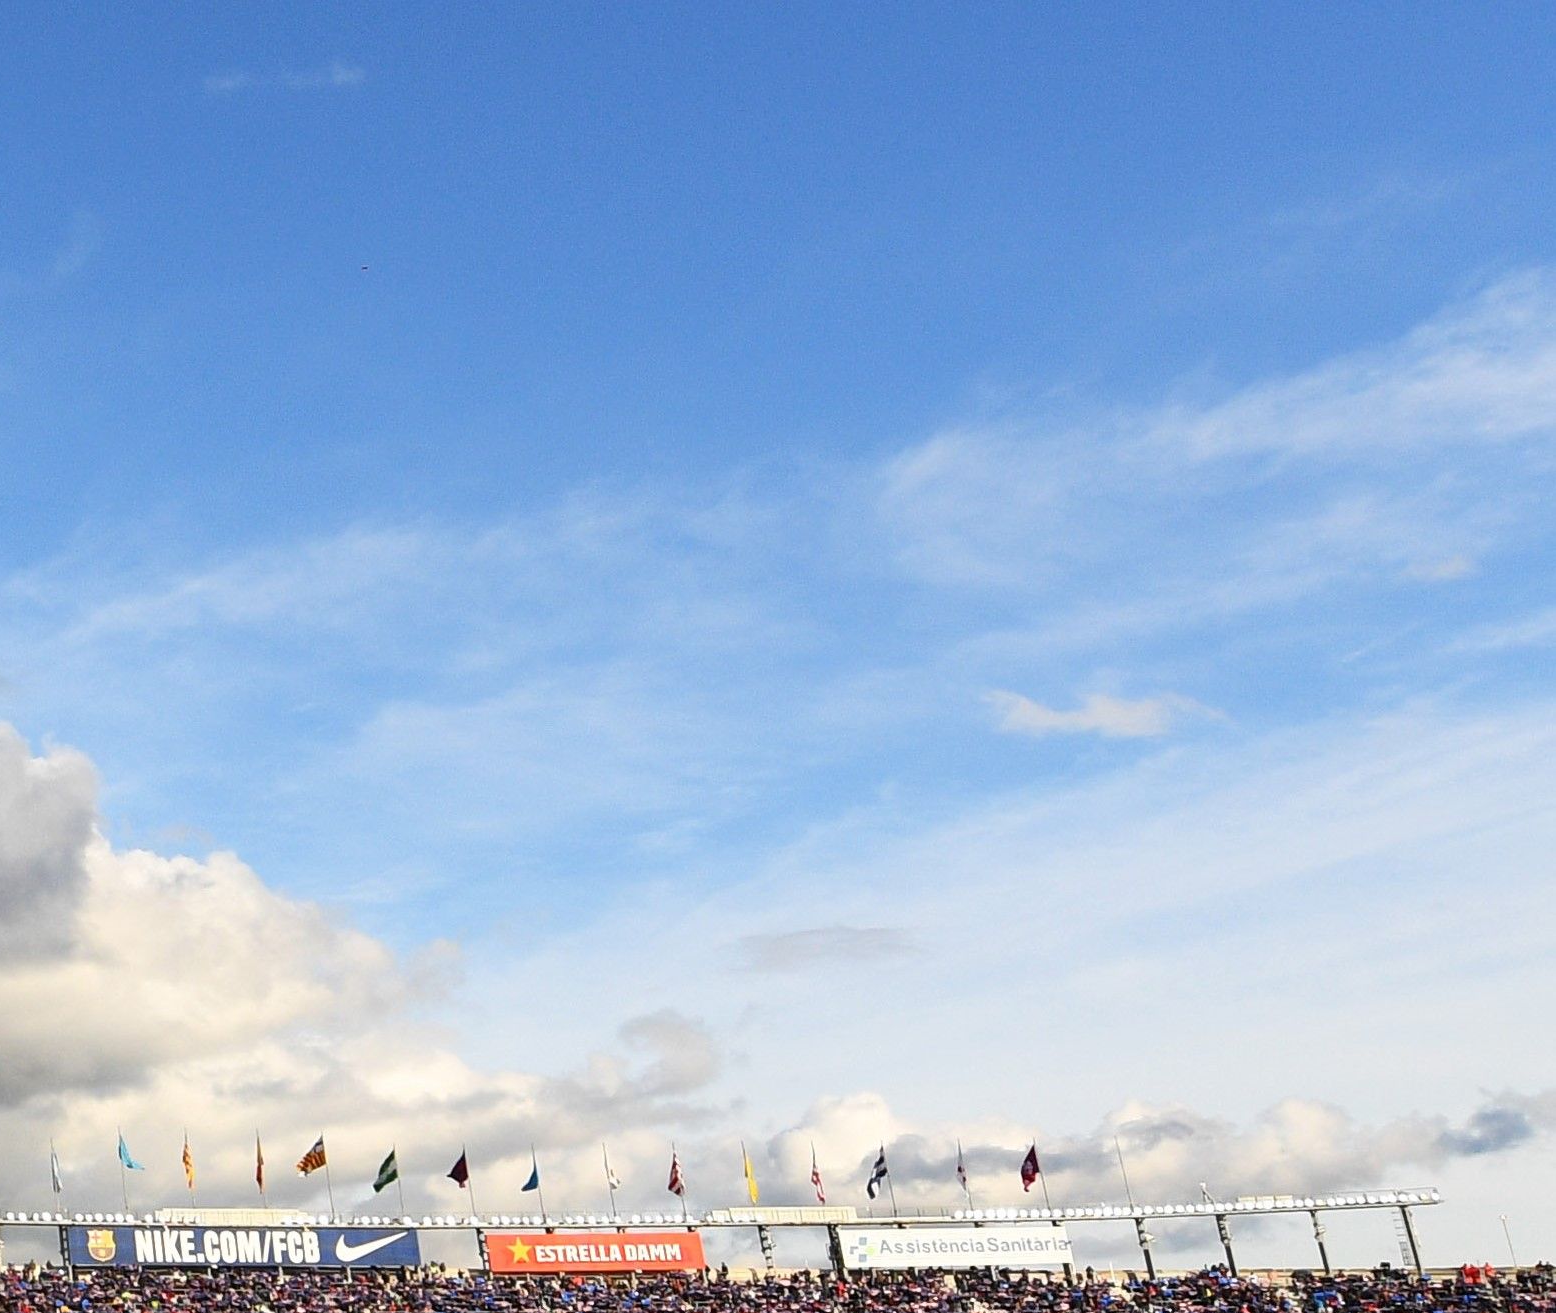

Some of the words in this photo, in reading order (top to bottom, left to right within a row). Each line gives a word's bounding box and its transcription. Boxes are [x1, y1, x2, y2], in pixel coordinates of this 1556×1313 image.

[134, 1228, 320, 1264] NIKE.COM/FCB
[535, 1243, 620, 1263] ESTRELLA
[623, 1242, 682, 1262] DAMM
